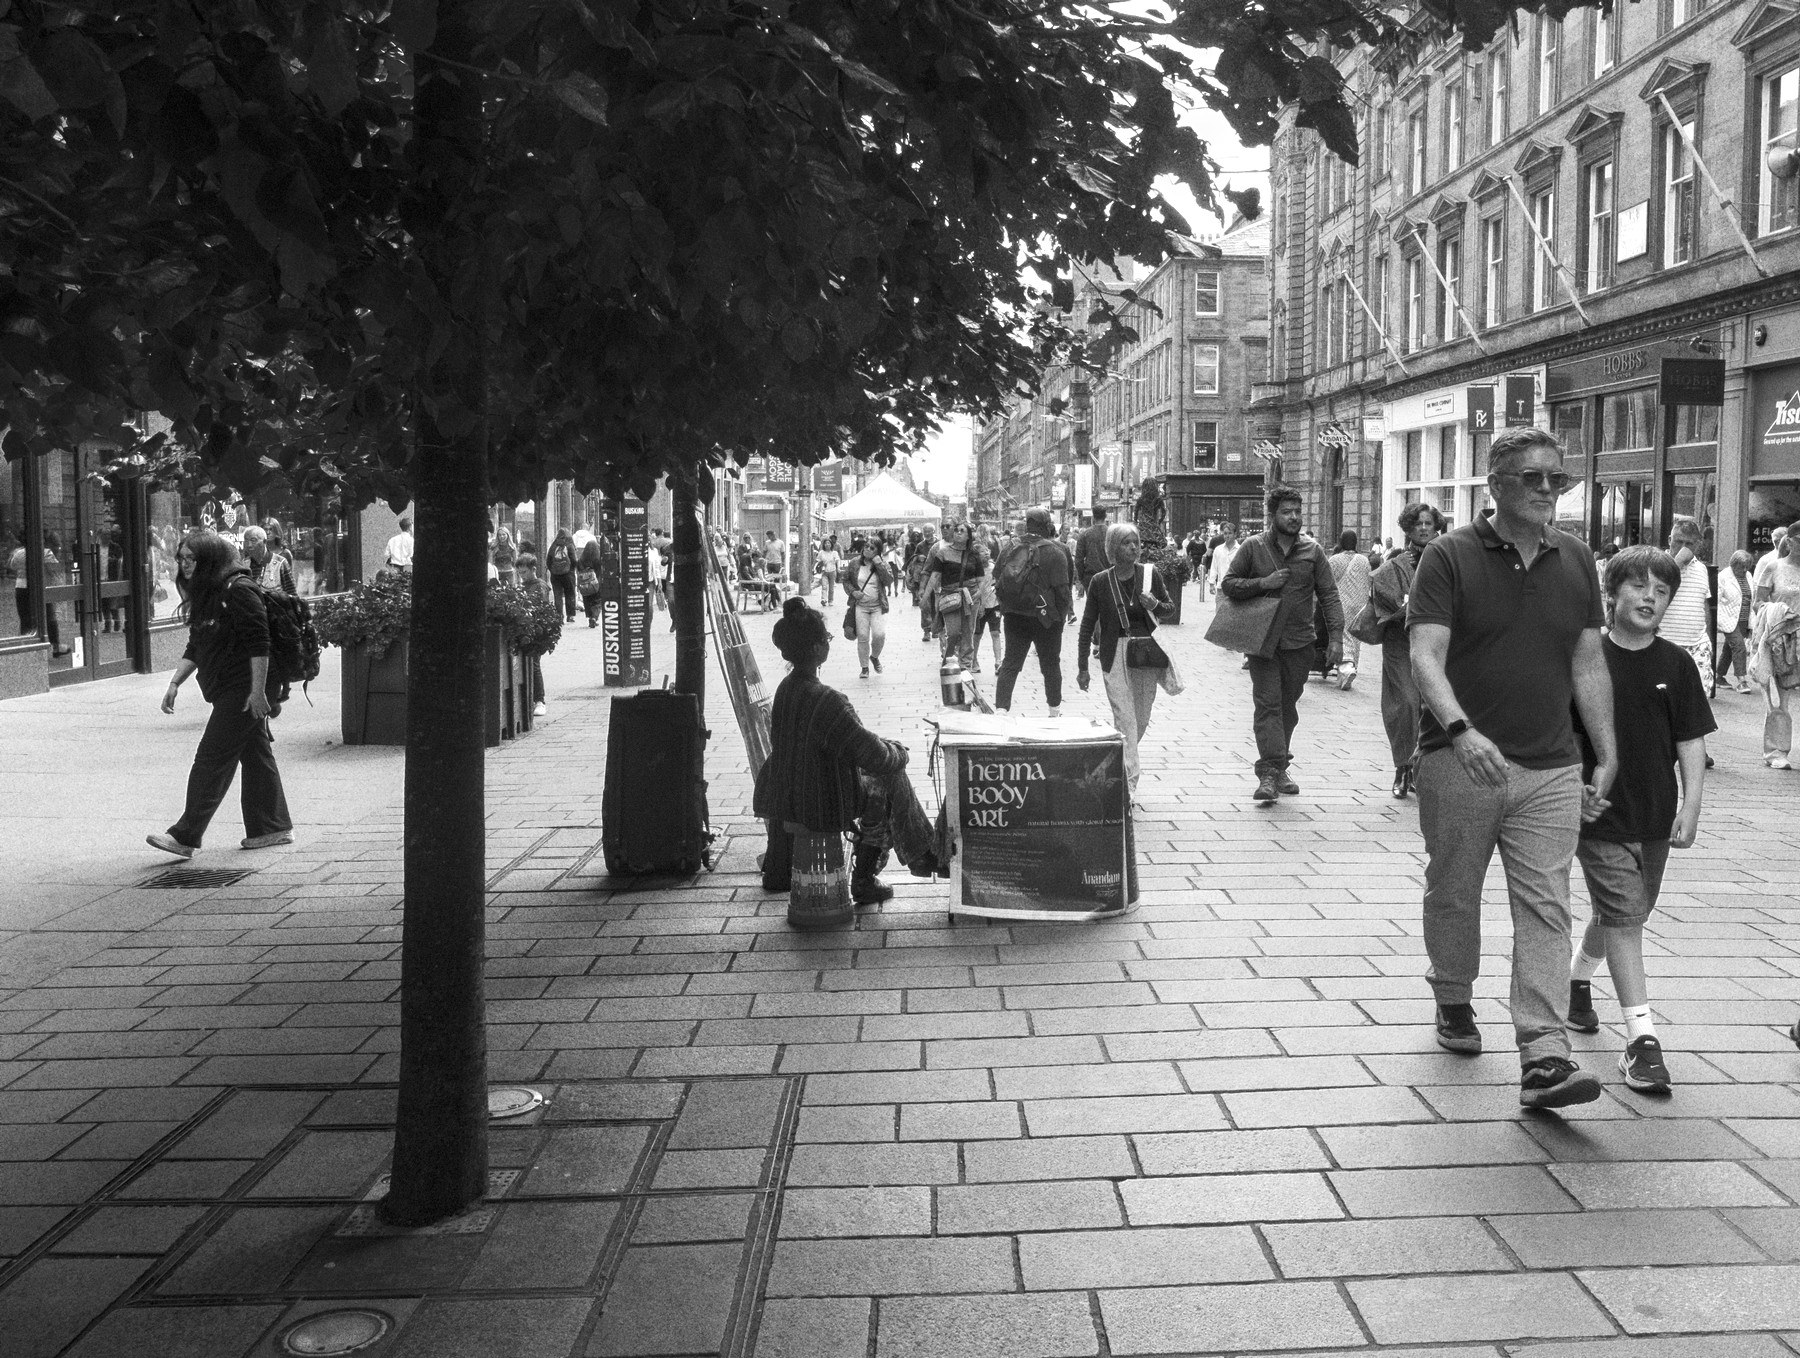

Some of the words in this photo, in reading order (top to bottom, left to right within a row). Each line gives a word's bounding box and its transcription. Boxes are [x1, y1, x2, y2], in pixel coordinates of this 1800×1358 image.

[1603, 350, 1643, 375] HOBBS
[604, 601, 619, 675] BUSKING
[968, 755, 1046, 781] henna
